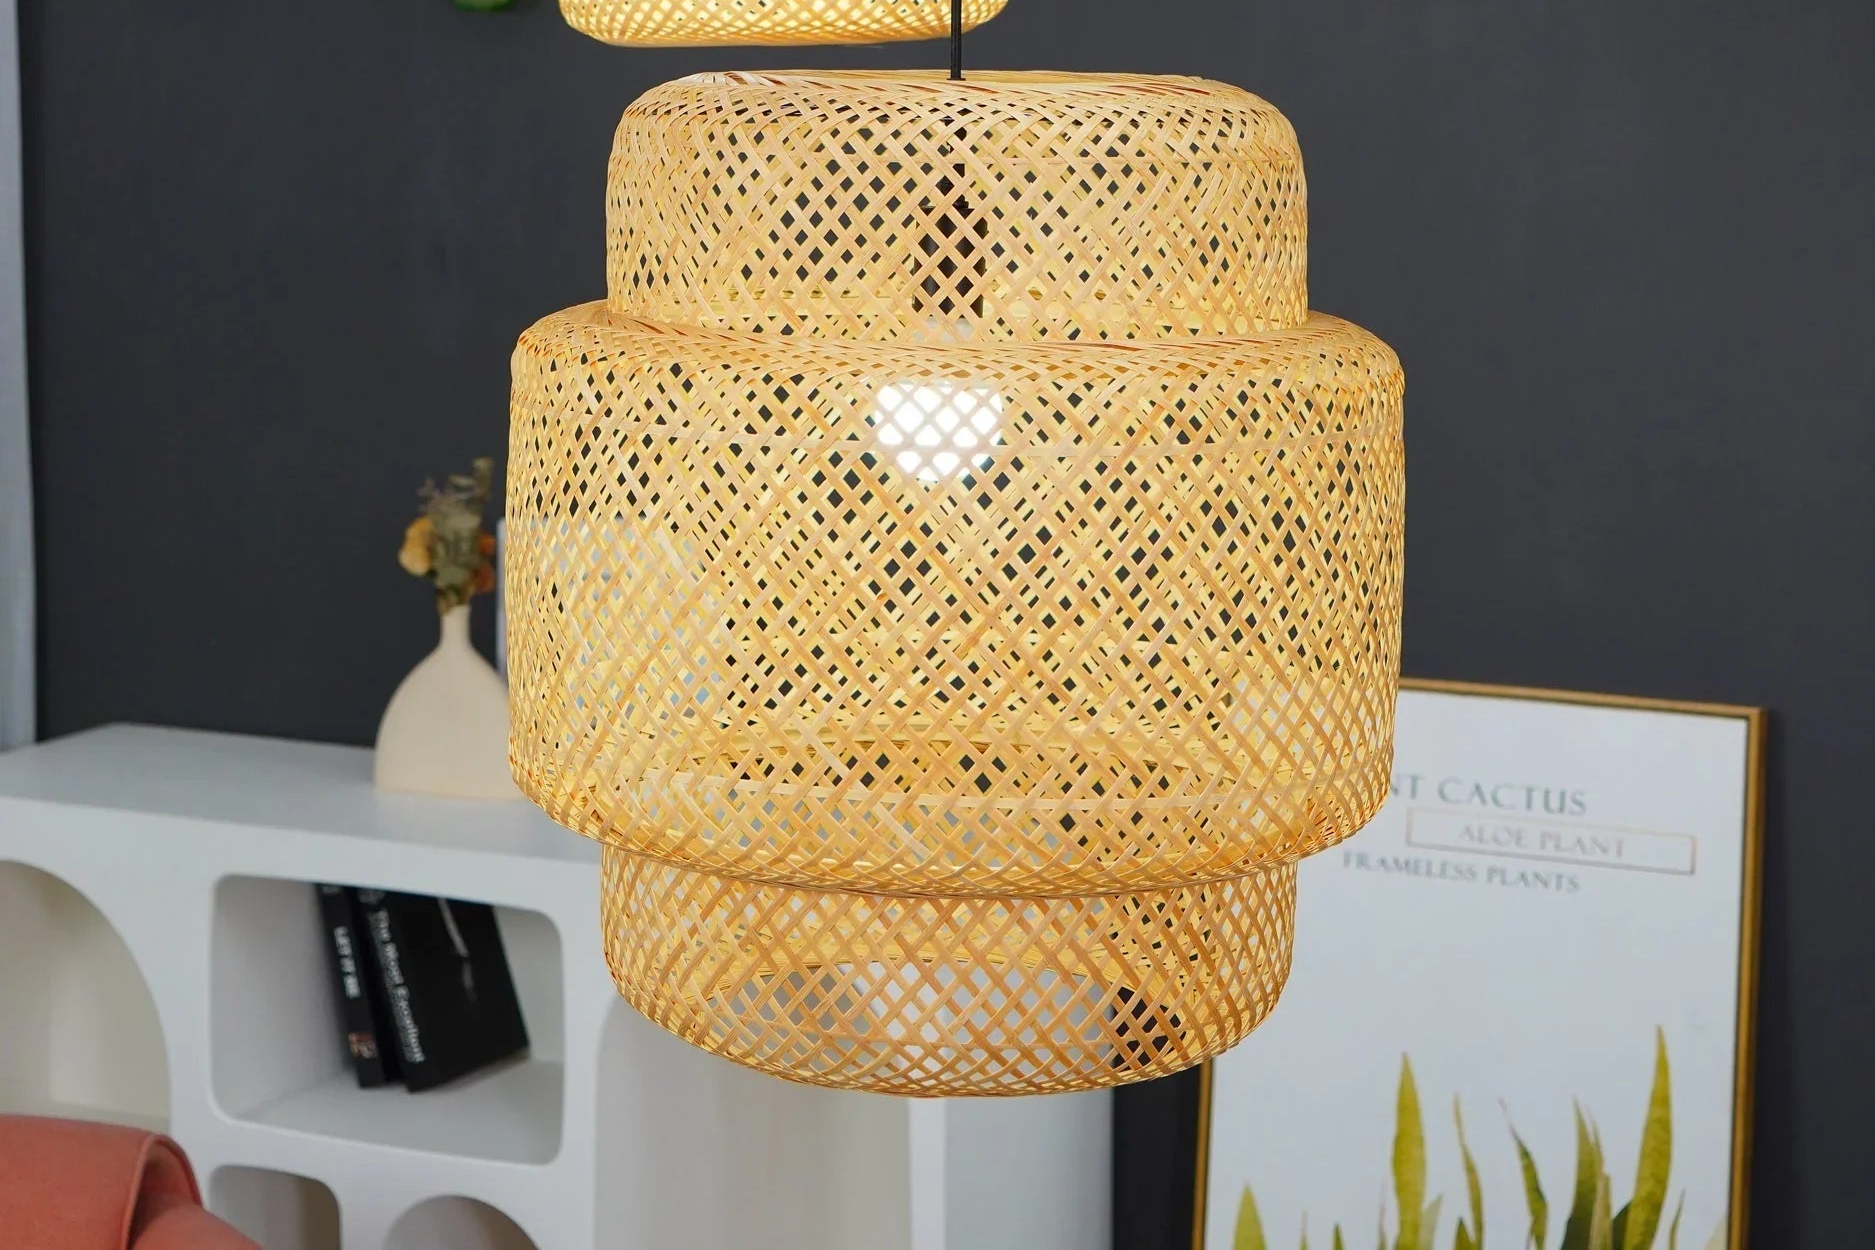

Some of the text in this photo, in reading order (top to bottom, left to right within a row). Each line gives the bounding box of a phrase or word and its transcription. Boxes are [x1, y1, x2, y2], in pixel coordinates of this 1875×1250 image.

[1437, 777, 1587, 816] CACTUS
[1460, 824, 1625, 859] ALOE PLANT
[1342, 851, 1581, 894] FRAMELESS PLANTS
